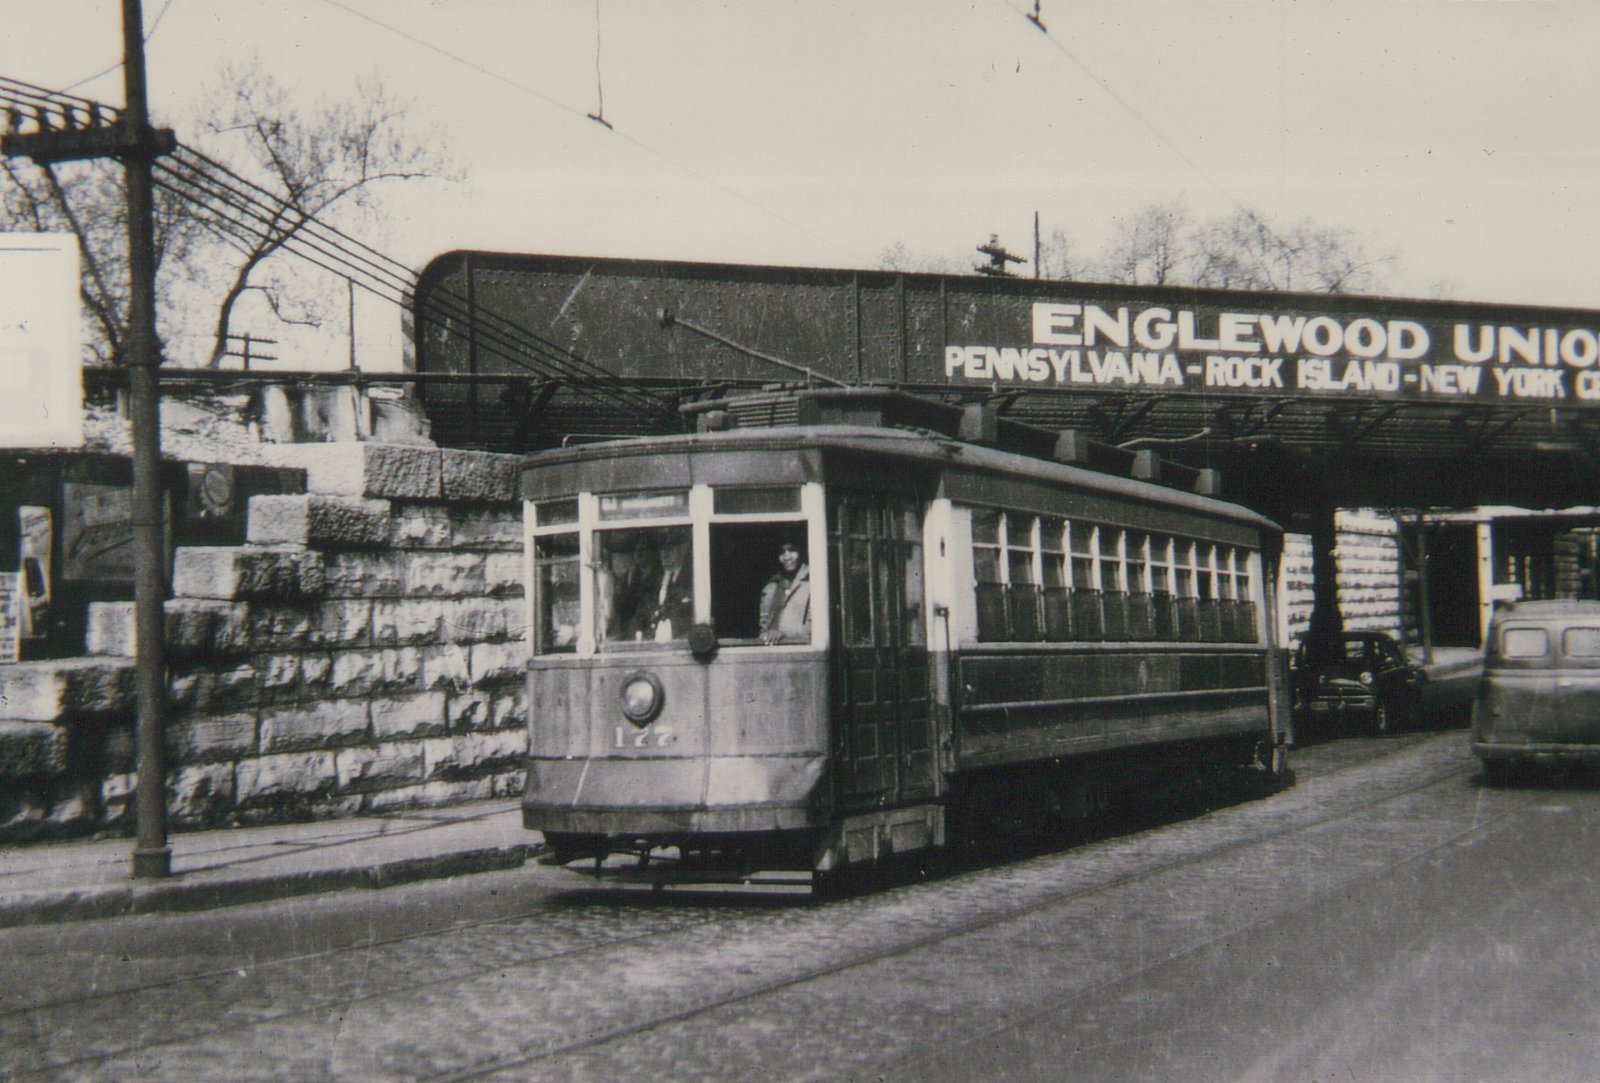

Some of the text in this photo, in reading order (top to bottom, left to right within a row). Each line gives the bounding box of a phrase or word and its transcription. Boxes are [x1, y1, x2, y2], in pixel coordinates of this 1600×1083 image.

[1032, 303, 1600, 368] ENGLEWOOD UNIO
[1492, 367, 1566, 398] YORK
[615, 725, 672, 748] 177
